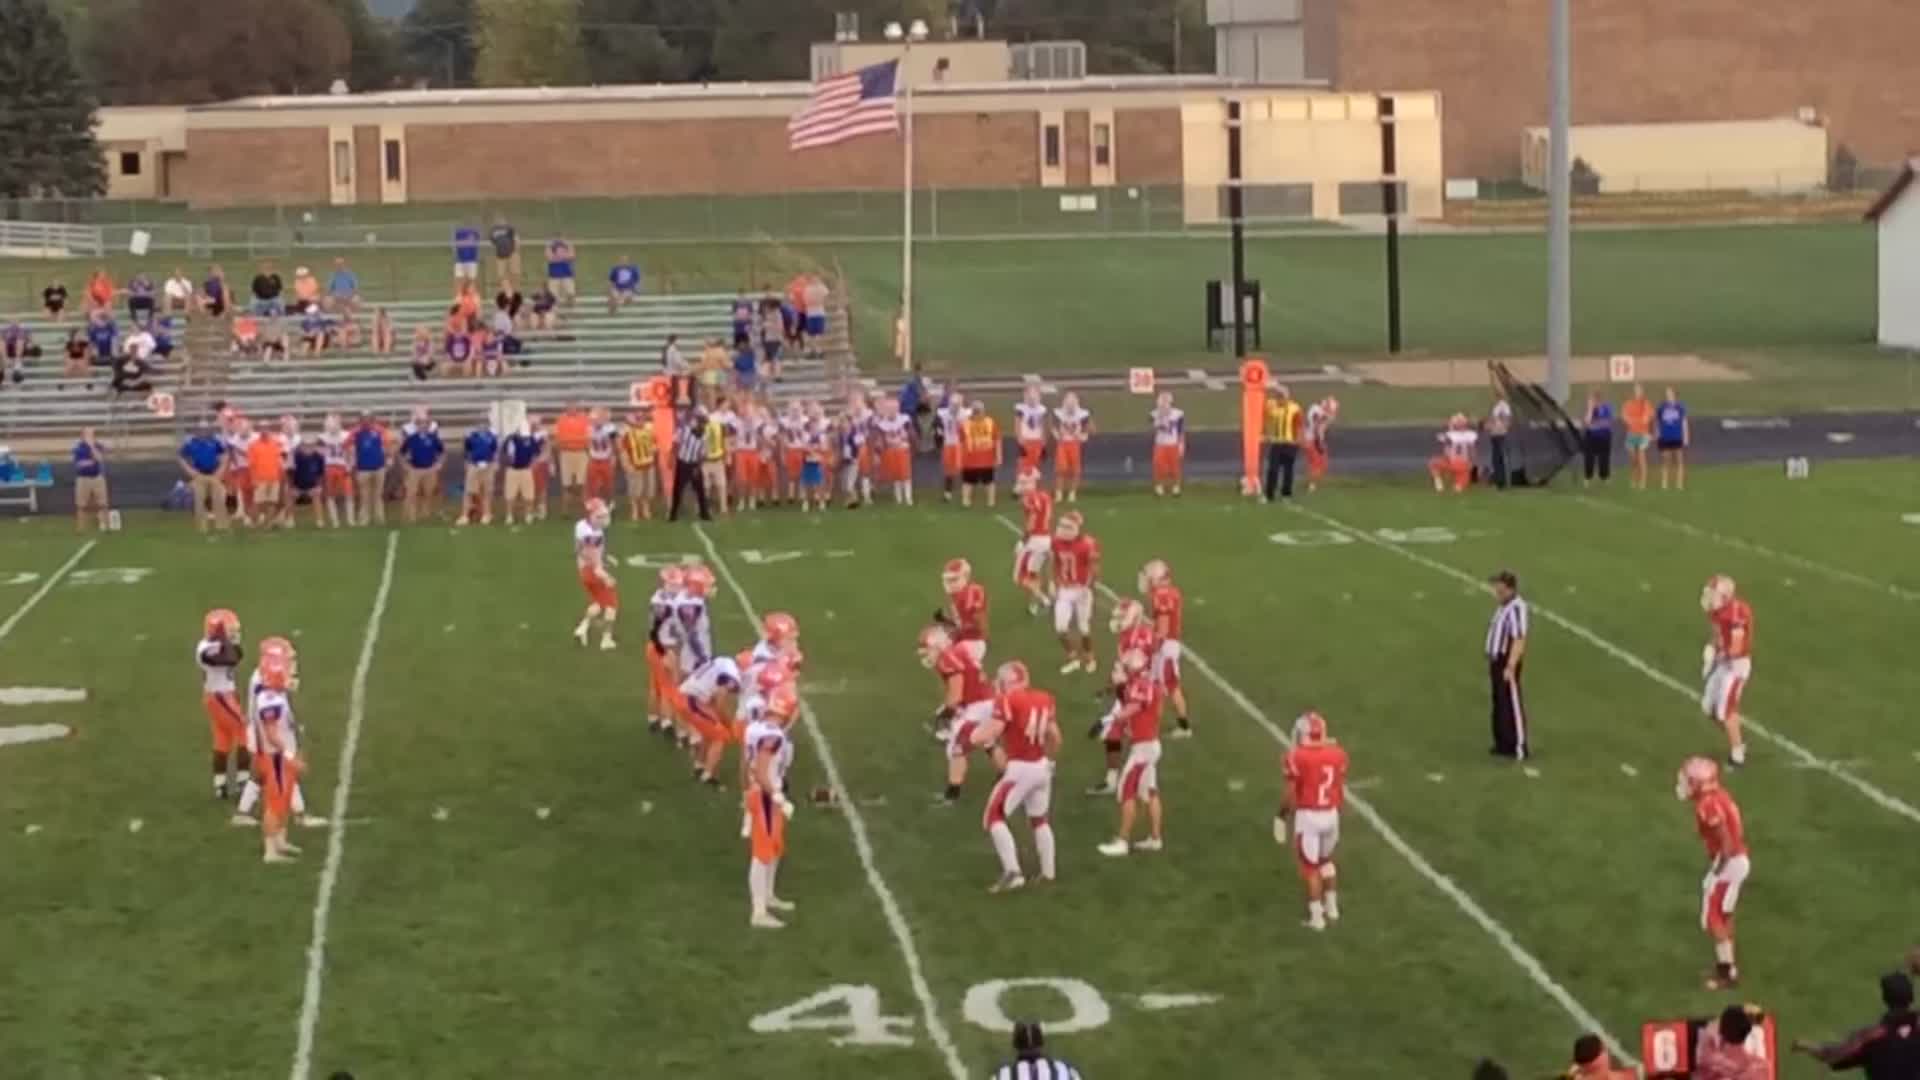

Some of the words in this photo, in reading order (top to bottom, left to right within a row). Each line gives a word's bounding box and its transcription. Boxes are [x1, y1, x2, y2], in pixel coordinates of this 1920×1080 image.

[1317, 765, 1335, 806] 2
[748, 977, 1110, 1046] 40
[1653, 1029, 1678, 1071] 6
